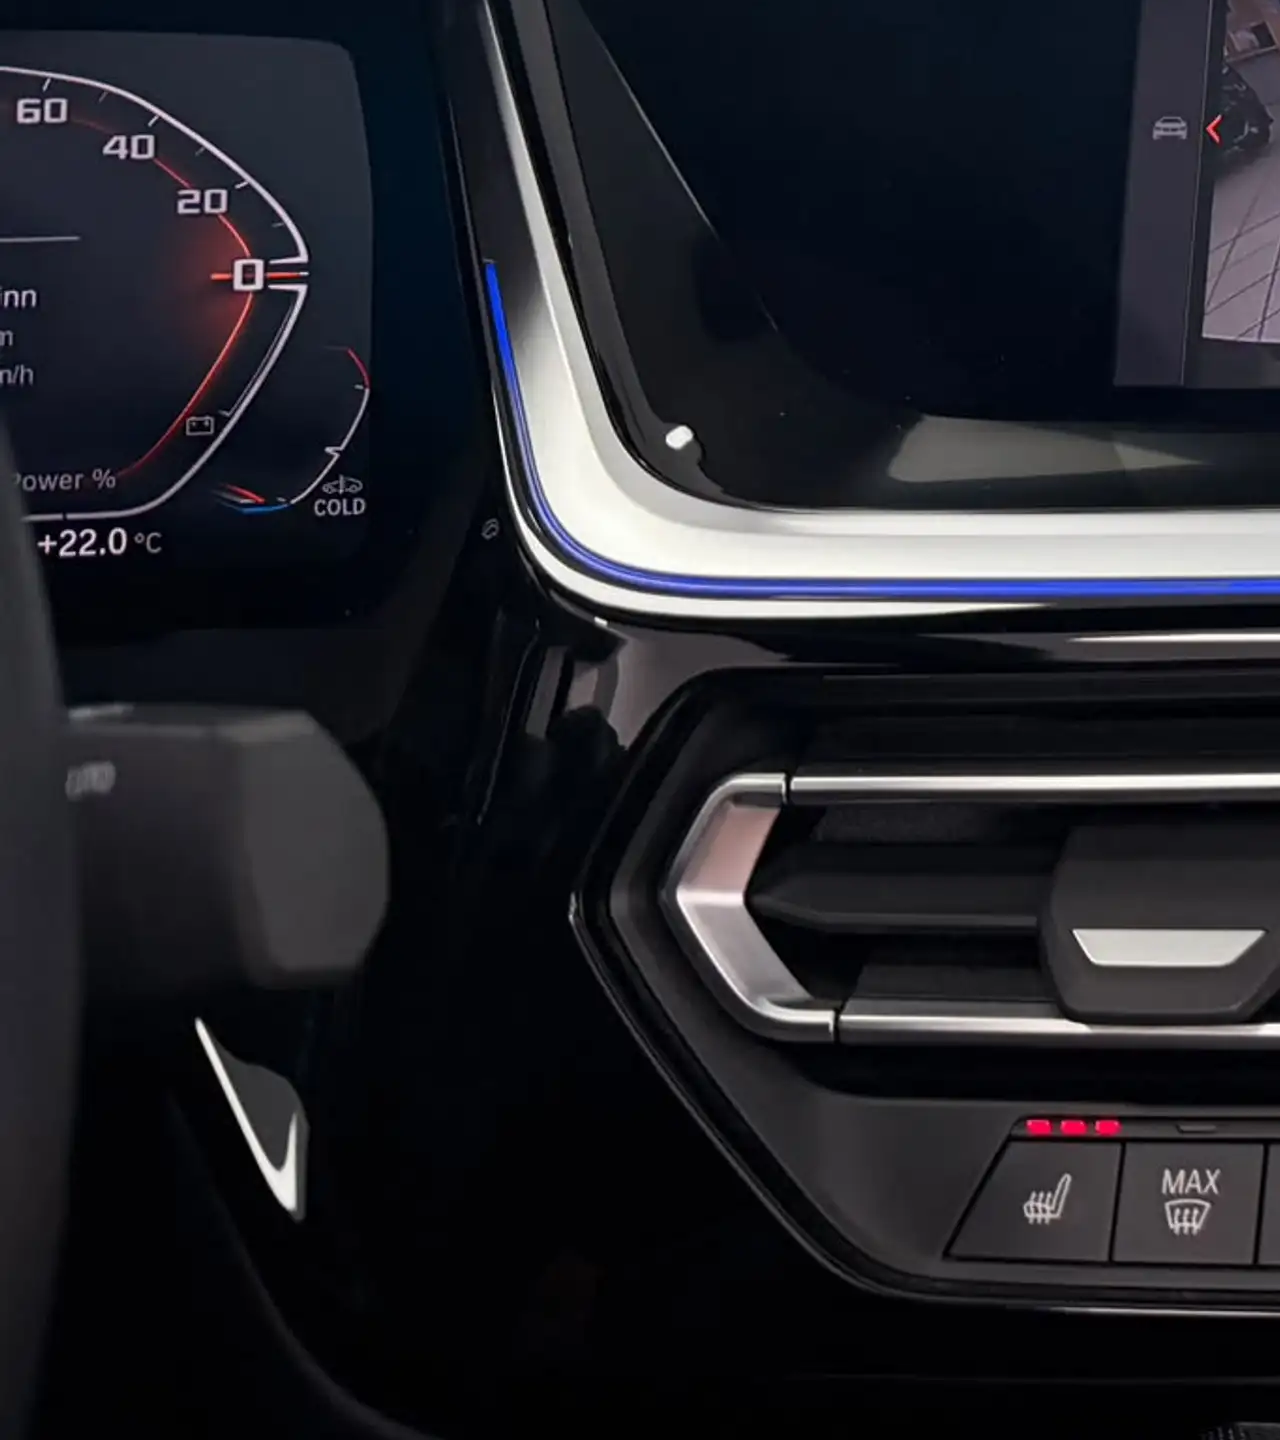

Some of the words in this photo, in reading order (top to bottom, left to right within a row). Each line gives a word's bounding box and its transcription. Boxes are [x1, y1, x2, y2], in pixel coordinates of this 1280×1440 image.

[15, 97, 69, 124] 60
[102, 134, 156, 160] 40
[176, 188, 229, 215] 20
[232, 258, 265, 292] 0
[92, 468, 116, 489] %
[313, 498, 367, 516] COLD
[37, 527, 129, 558] +22.0
[1161, 1168, 1221, 1196] MAX
